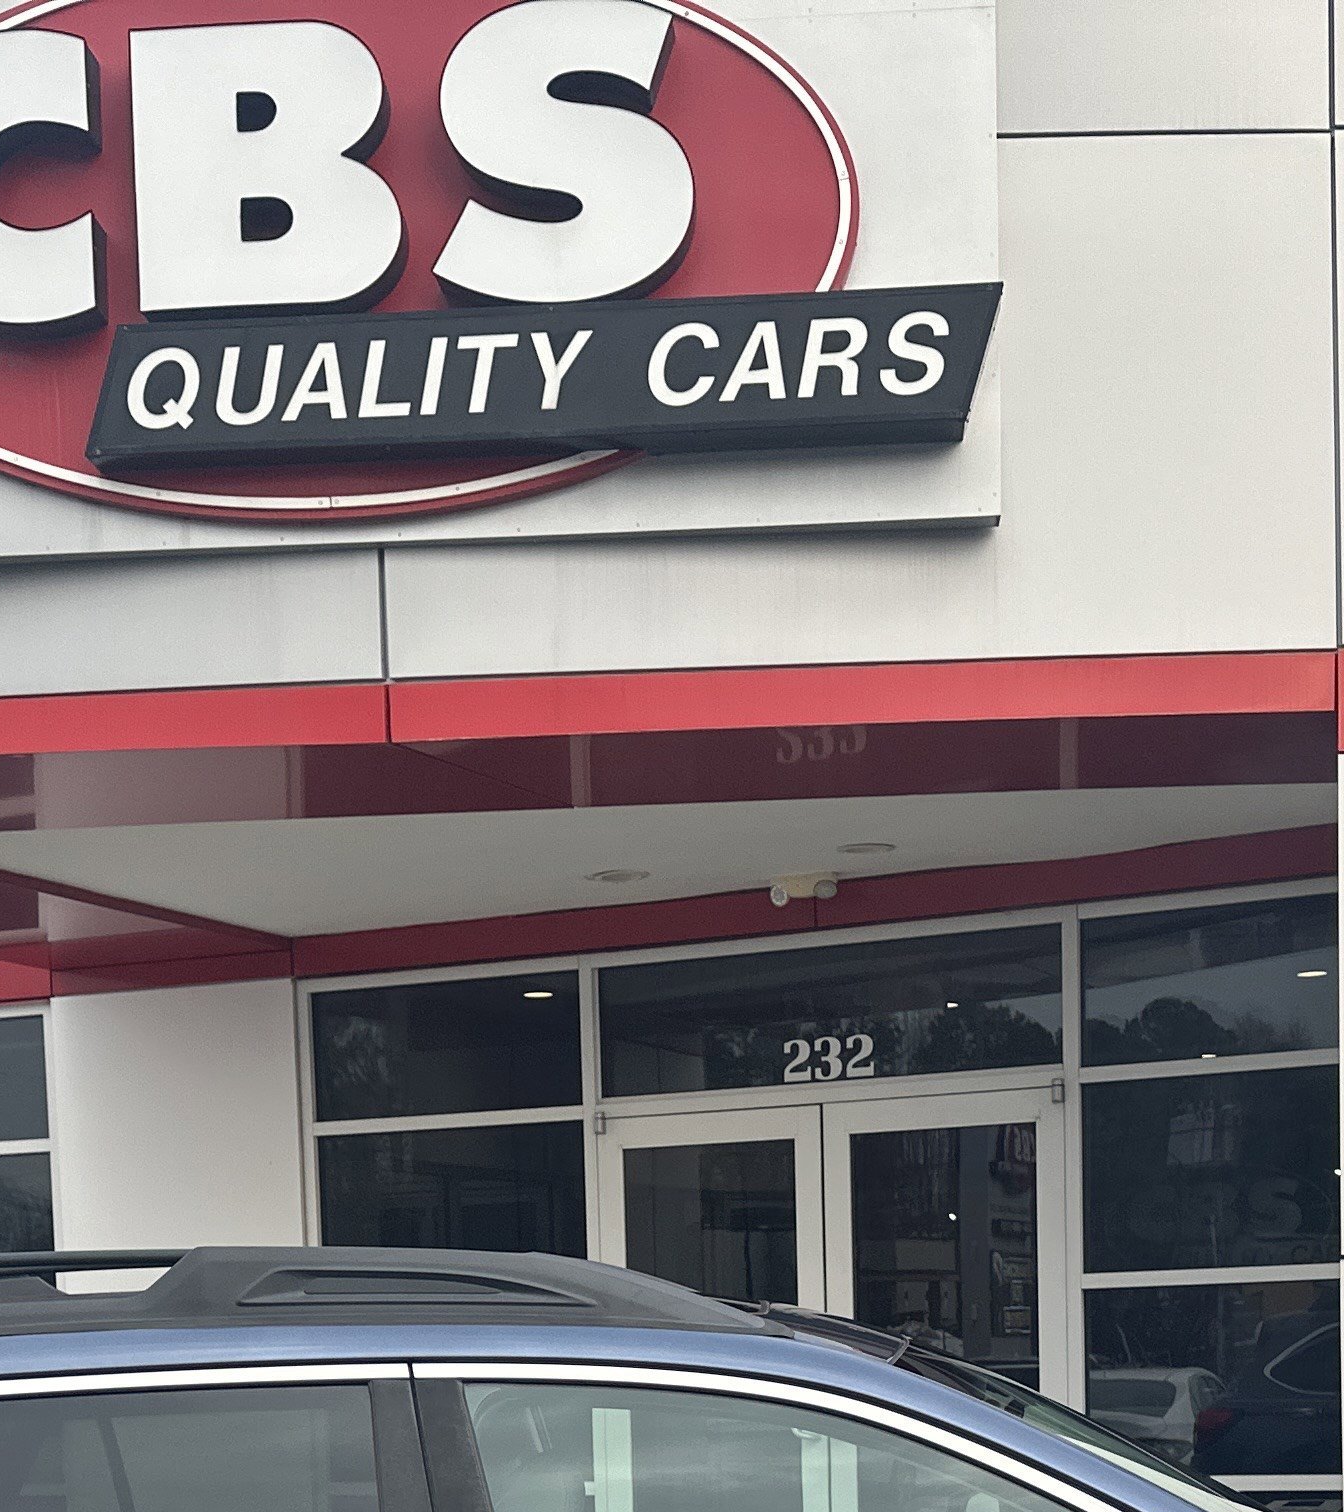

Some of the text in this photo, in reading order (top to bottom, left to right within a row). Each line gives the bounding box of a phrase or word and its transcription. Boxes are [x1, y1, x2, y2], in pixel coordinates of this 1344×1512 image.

[126, 311, 950, 430] QUALITY CARS
[782, 1033, 876, 1083] 232
